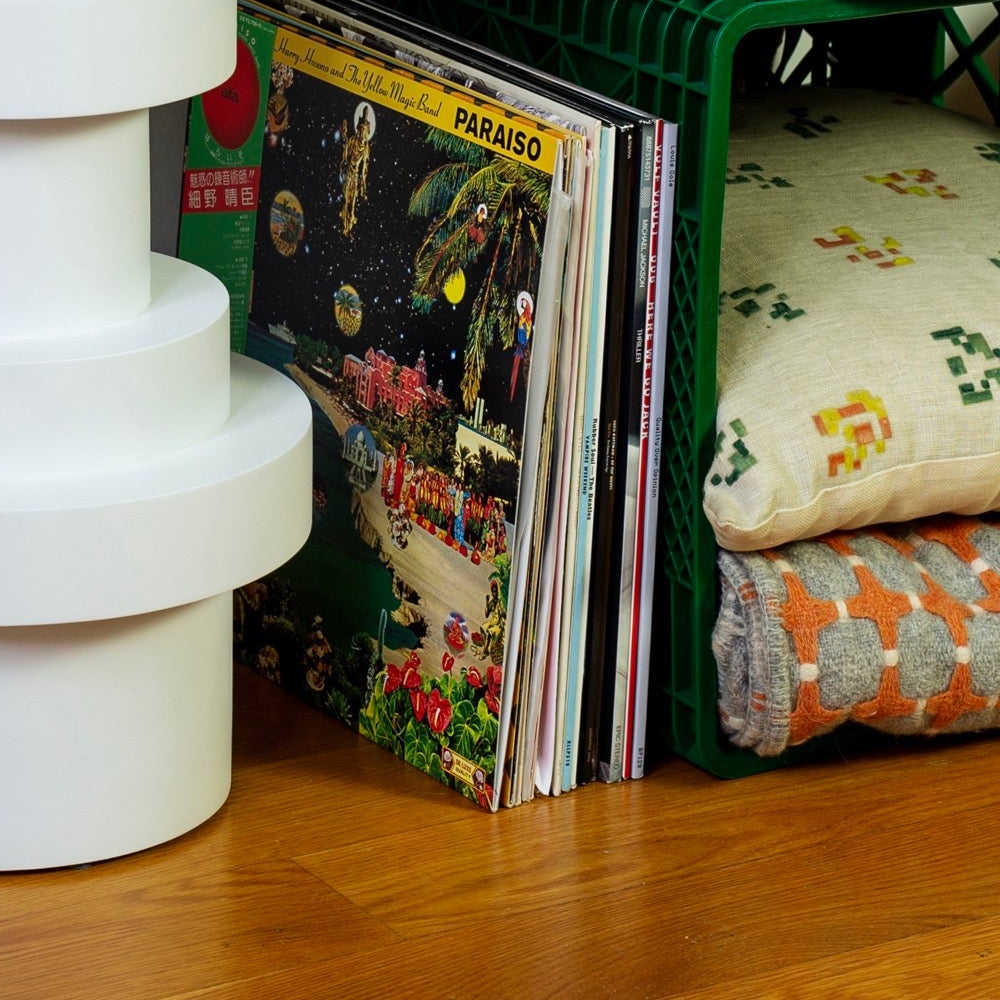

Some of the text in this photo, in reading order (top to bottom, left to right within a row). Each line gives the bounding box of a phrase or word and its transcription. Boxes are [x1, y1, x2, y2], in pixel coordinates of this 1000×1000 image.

[274, 37, 300, 65] Harry
[299, 48, 329, 73] Hosono
[330, 63, 348, 79] and
[345, 65, 362, 86] The
[362, 70, 389, 97] Yellow
[389, 81, 417, 111] Magic
[416, 93, 443, 118] Band
[453, 106, 542, 162] PARAISO
[669, 145, 677, 168] Louis
[639, 220, 649, 288] MICHAEL JACKSON
[647, 302, 655, 340] HERE
[635, 328, 643, 363] THRILLER
[645, 348, 652, 369] WE
[641, 404, 649, 438] JACK
[654, 417, 662, 446] Quality
[651, 470, 659, 498] Opinion
[586, 493, 594, 521] Beatles
[613, 742, 621, 770] STEREO
